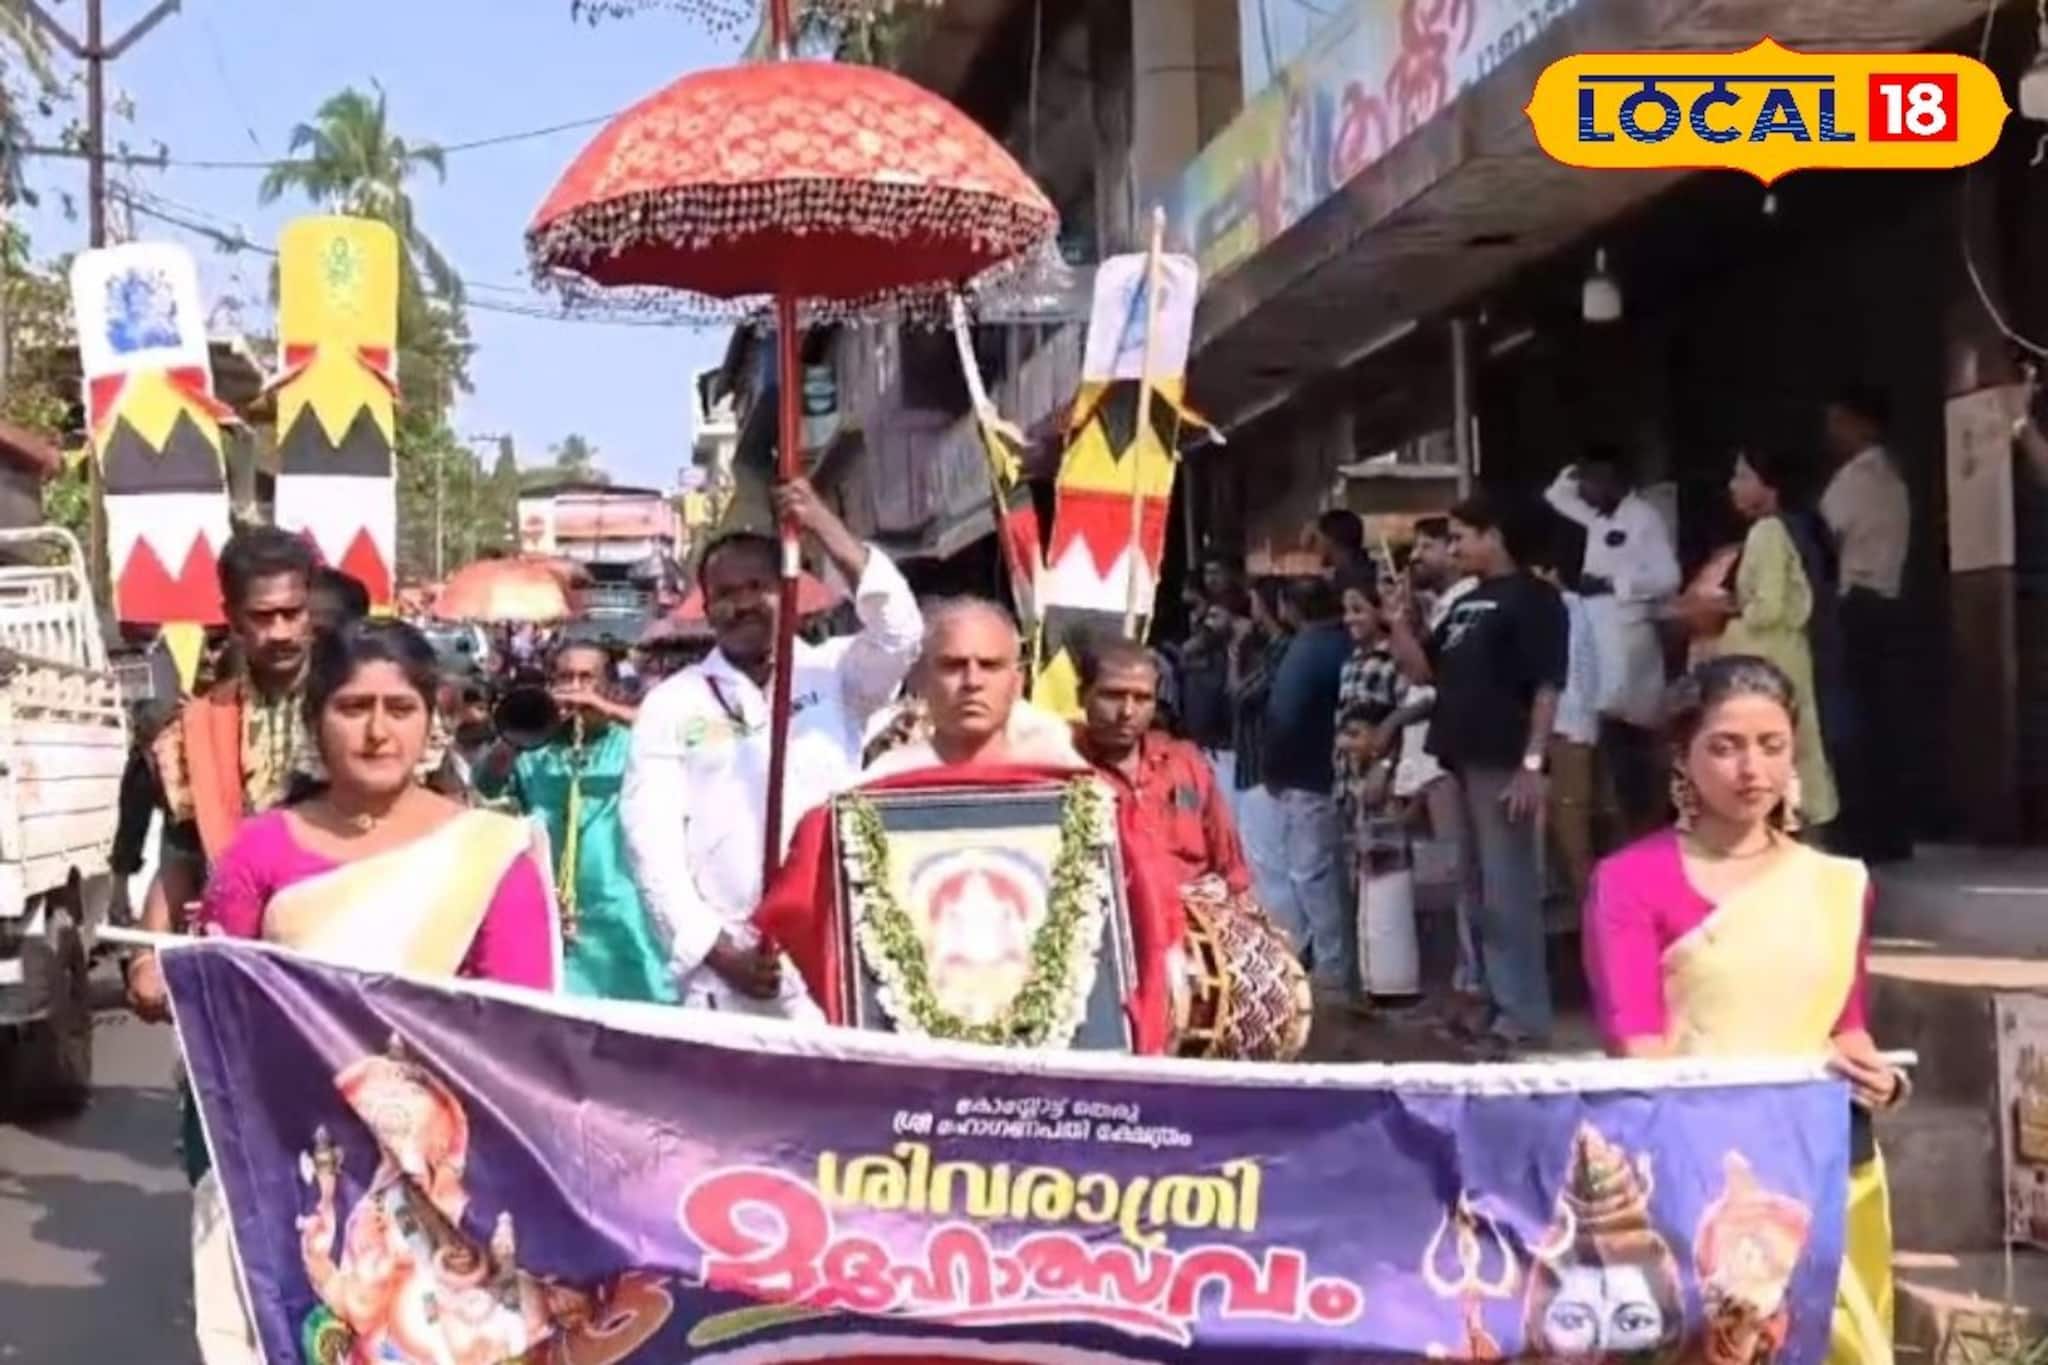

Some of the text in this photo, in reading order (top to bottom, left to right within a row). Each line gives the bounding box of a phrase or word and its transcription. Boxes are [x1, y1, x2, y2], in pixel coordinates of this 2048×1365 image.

[892, 1109, 933, 1135] ശ്രീ
[677, 1164, 1364, 1326] മഹോത്സവം
[816, 1141, 1262, 1246] ശിവരാത്രി
